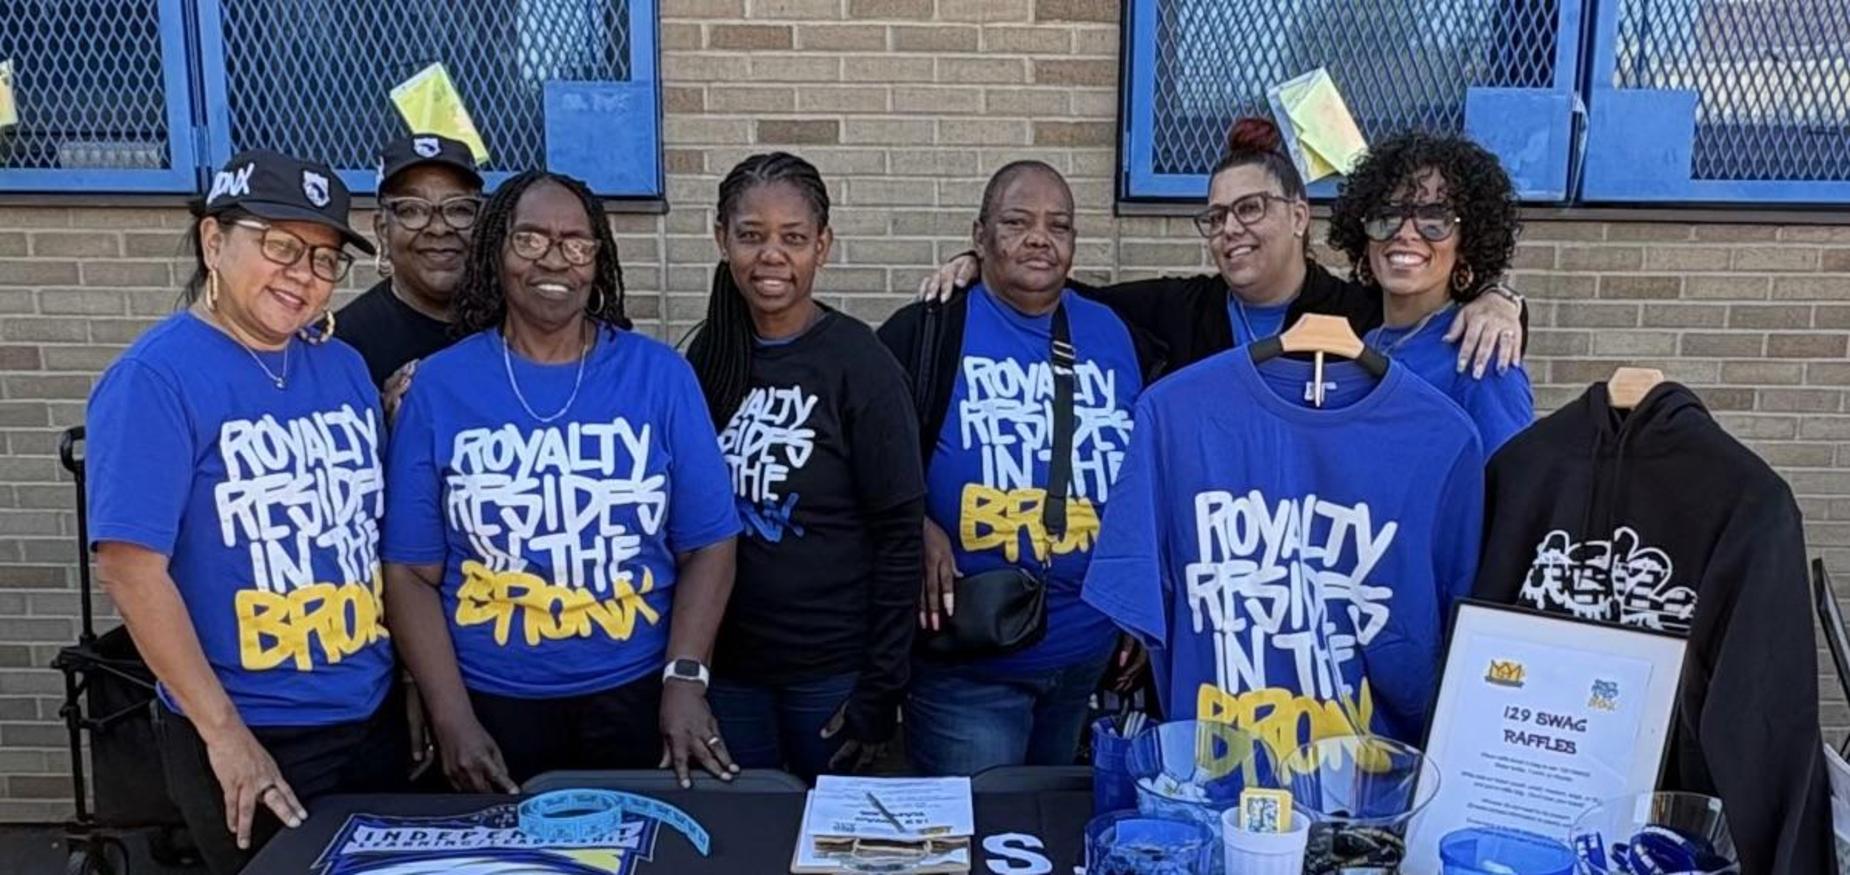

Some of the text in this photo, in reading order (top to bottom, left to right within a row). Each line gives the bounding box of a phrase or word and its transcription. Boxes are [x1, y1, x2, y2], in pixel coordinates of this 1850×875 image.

[729, 385, 818, 431] ALTY
[219, 404, 380, 484] ROYALTY
[451, 416, 650, 482] ROYALTY
[717, 420, 816, 469] SIDES
[982, 442, 1126, 503] IN HE
[214, 467, 385, 547] RESIDE
[446, 473, 667, 539] RESIDES
[724, 455, 789, 503] THE
[250, 517, 381, 593] IN THE
[528, 533, 641, 592] THE
[1195, 489, 1398, 585] ROYALTY
[455, 560, 659, 646] BRONX
[1185, 560, 1393, 645] RESIDES
[1213, 625, 1356, 701] IN THE
[1503, 729, 1576, 754] RAFFLES
[1504, 705, 1587, 732] 129 SWAG
[364, 826, 632, 842] INDEPENT
